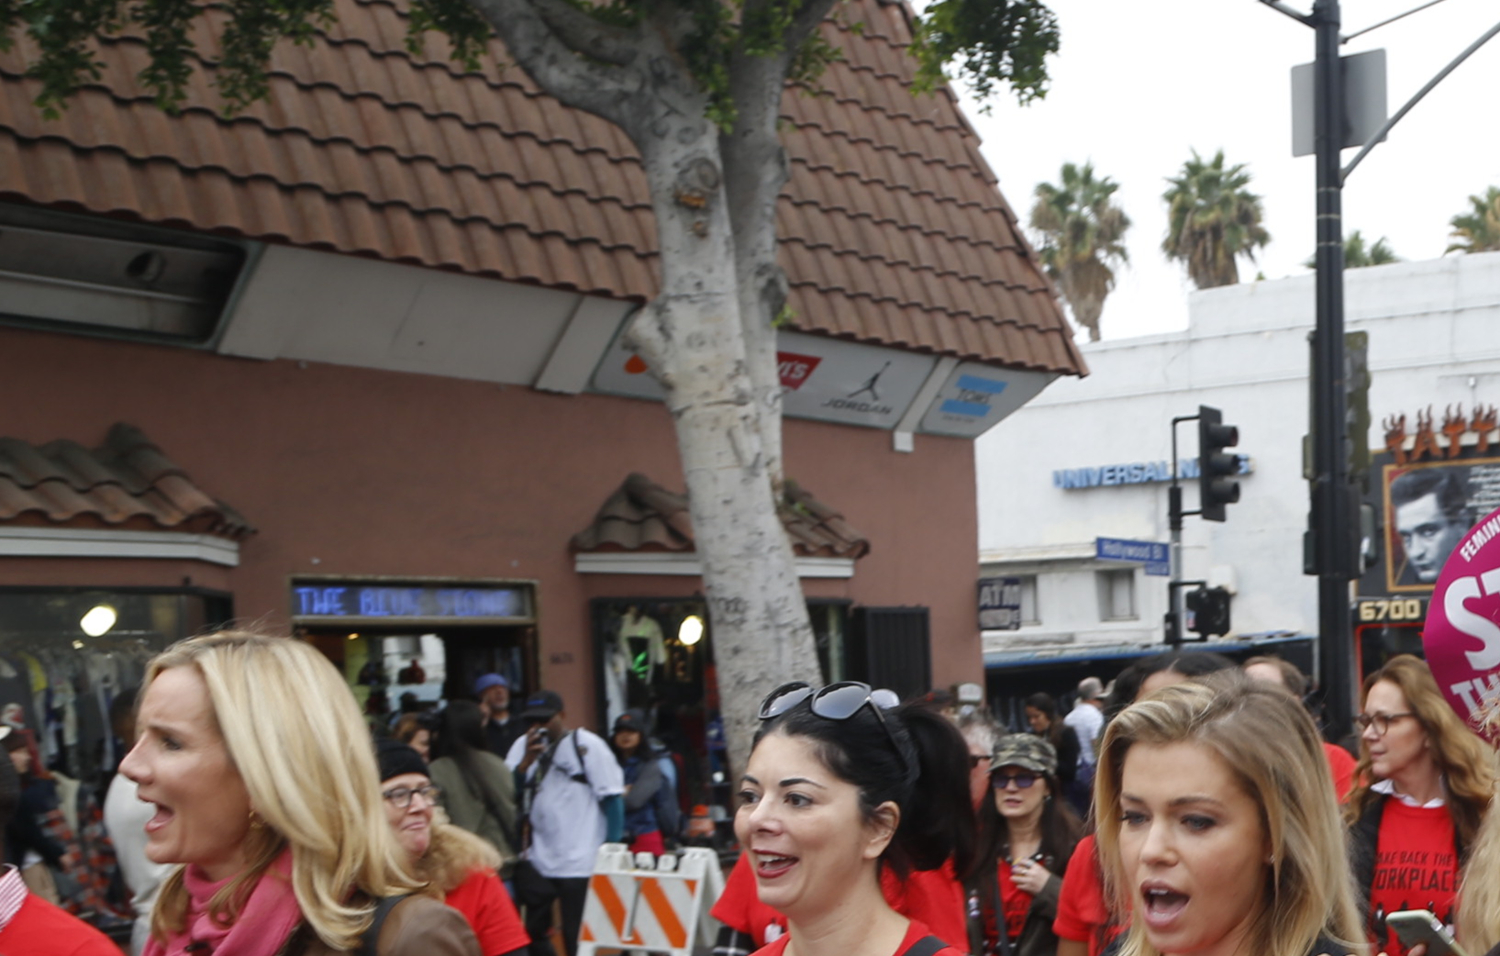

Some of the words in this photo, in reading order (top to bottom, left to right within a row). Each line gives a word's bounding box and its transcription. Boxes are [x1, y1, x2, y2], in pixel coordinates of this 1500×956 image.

[821, 397, 892, 415] JORDAN
[1052, 460, 1172, 489] UNIVERSAL
[1102, 541, 1150, 560] Hollywood
[295, 588, 346, 615] THE
[980, 585, 1021, 607] ATM
[1360, 600, 1420, 621] 6700
[1400, 851, 1429, 865] BACK
[1374, 867, 1463, 892] ORKPLACE
